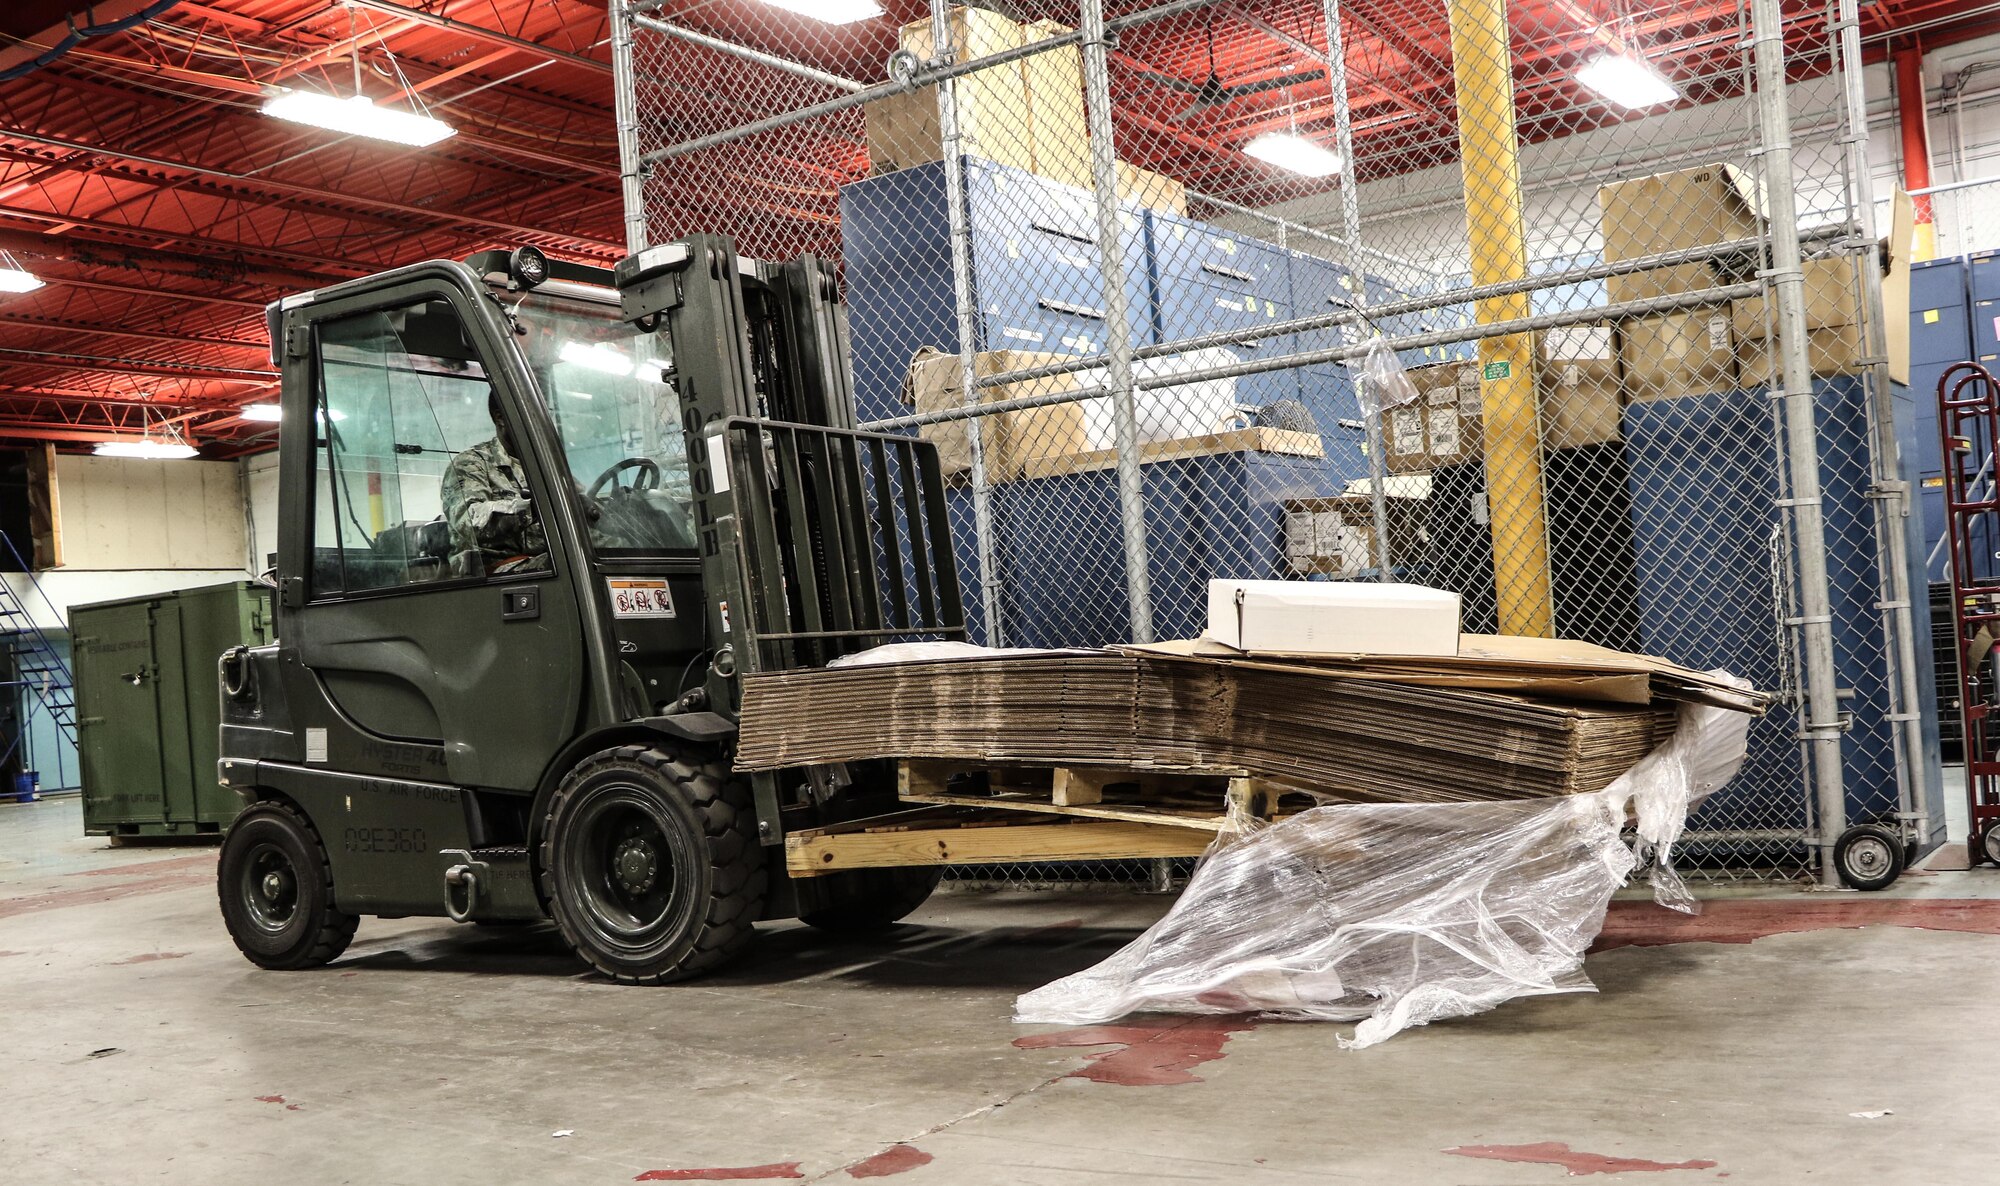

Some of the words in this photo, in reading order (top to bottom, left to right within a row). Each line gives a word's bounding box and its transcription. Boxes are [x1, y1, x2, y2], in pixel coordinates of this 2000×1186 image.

[1693, 172, 1710, 184] WD
[362, 742, 422, 763] HYSTER
[382, 762, 421, 775] FORTIS
[389, 783, 409, 797] AIR
[416, 787, 457, 804] FORCE
[345, 827, 427, 853] 09E360
